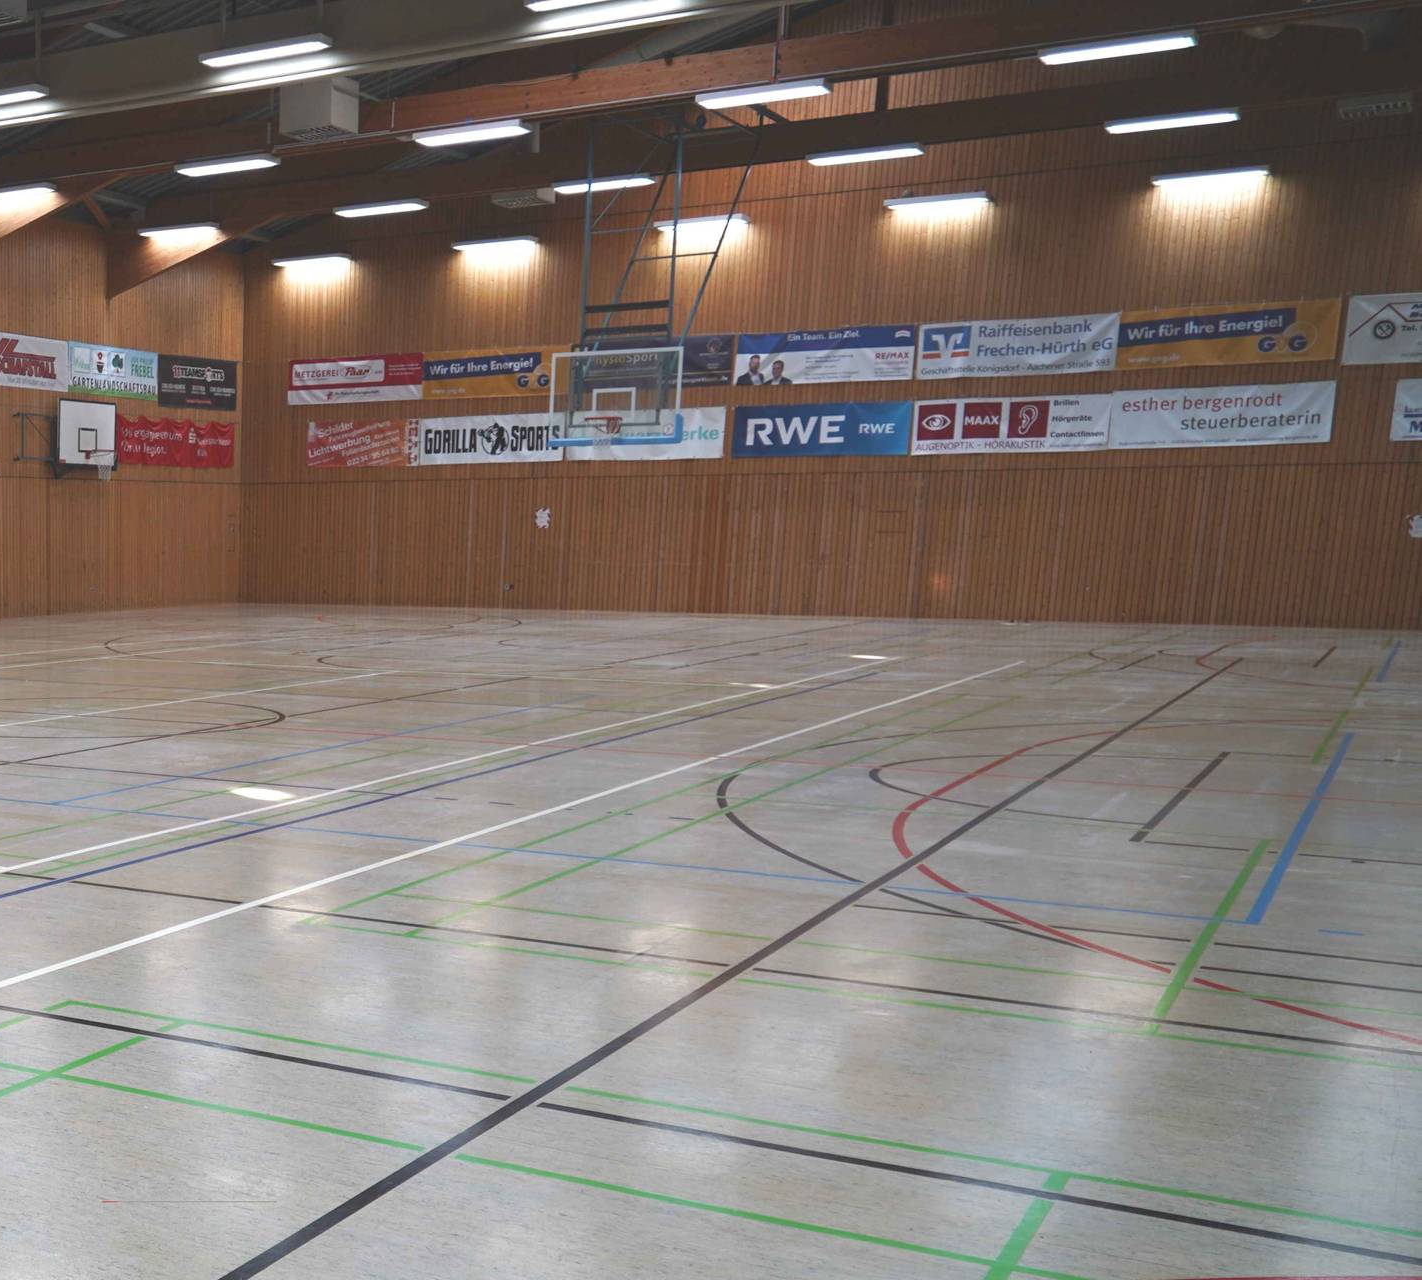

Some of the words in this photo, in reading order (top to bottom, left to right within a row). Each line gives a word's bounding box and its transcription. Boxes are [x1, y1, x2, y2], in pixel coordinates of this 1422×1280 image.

[787, 332, 801, 342] Ein
[828, 331, 842, 340] Ein
[978, 319, 1093, 338] Raiffeisenbank
[1127, 327, 1155, 341] Wir
[1158, 324, 1181, 338] für
[1184, 320, 1215, 335] Ihre
[1218, 315, 1283, 332] Energie!
[874, 351, 910, 360] RE/MAX
[976, 339, 1086, 358] Frechen-Hürth
[1091, 337, 1113, 351] eG
[130, 363, 155, 379] FREBEL
[294, 369, 339, 379] METZGEREI
[429, 364, 448, 376] Wir
[450, 363, 465, 374] für
[467, 362, 489, 373] Ihre
[490, 357, 534, 372] Energie!
[977, 363, 1021, 374] Königsdorf
[1027, 361, 1066, 372] Aachener
[1067, 359, 1094, 369] Straße
[72, 375, 157, 396] GARTENLANDSCHAFTSBAU
[1122, 397, 1178, 413] esther
[1182, 392, 1283, 413] bergenrodt
[964, 415, 1000, 426] MAAX
[1052, 415, 1093, 423] Hörgeräte
[1180, 410, 1322, 431] steuerberaterin
[318, 421, 354, 438] Schilder
[746, 415, 846, 446] RWE
[858, 423, 896, 434] RWE
[308, 434, 371, 458] Lichtwerbung
[424, 428, 477, 455] GORILLA
[510, 425, 560, 452] SPORTS
[915, 440, 975, 451] AUGENOPTIK
